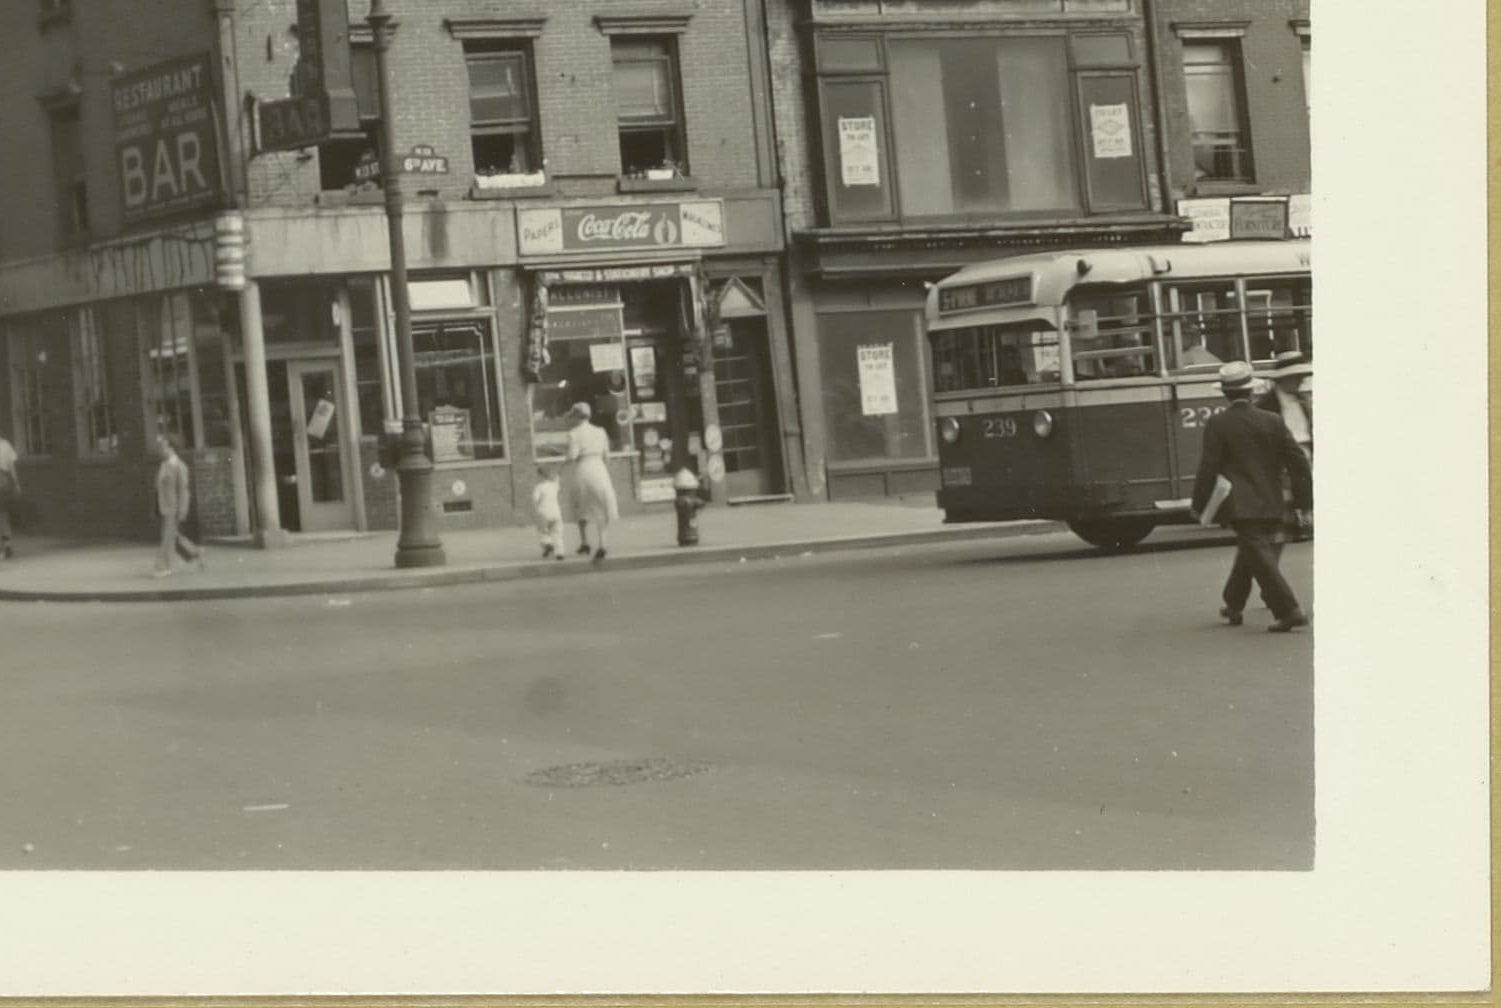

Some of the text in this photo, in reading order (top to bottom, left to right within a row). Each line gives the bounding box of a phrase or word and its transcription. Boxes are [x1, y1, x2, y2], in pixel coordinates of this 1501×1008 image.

[113, 64, 202, 111] RESTAURANT
[841, 120, 874, 132] STORE
[122, 131, 207, 207] BAR
[860, 350, 890, 361] STORE
[983, 419, 1016, 438] 239
